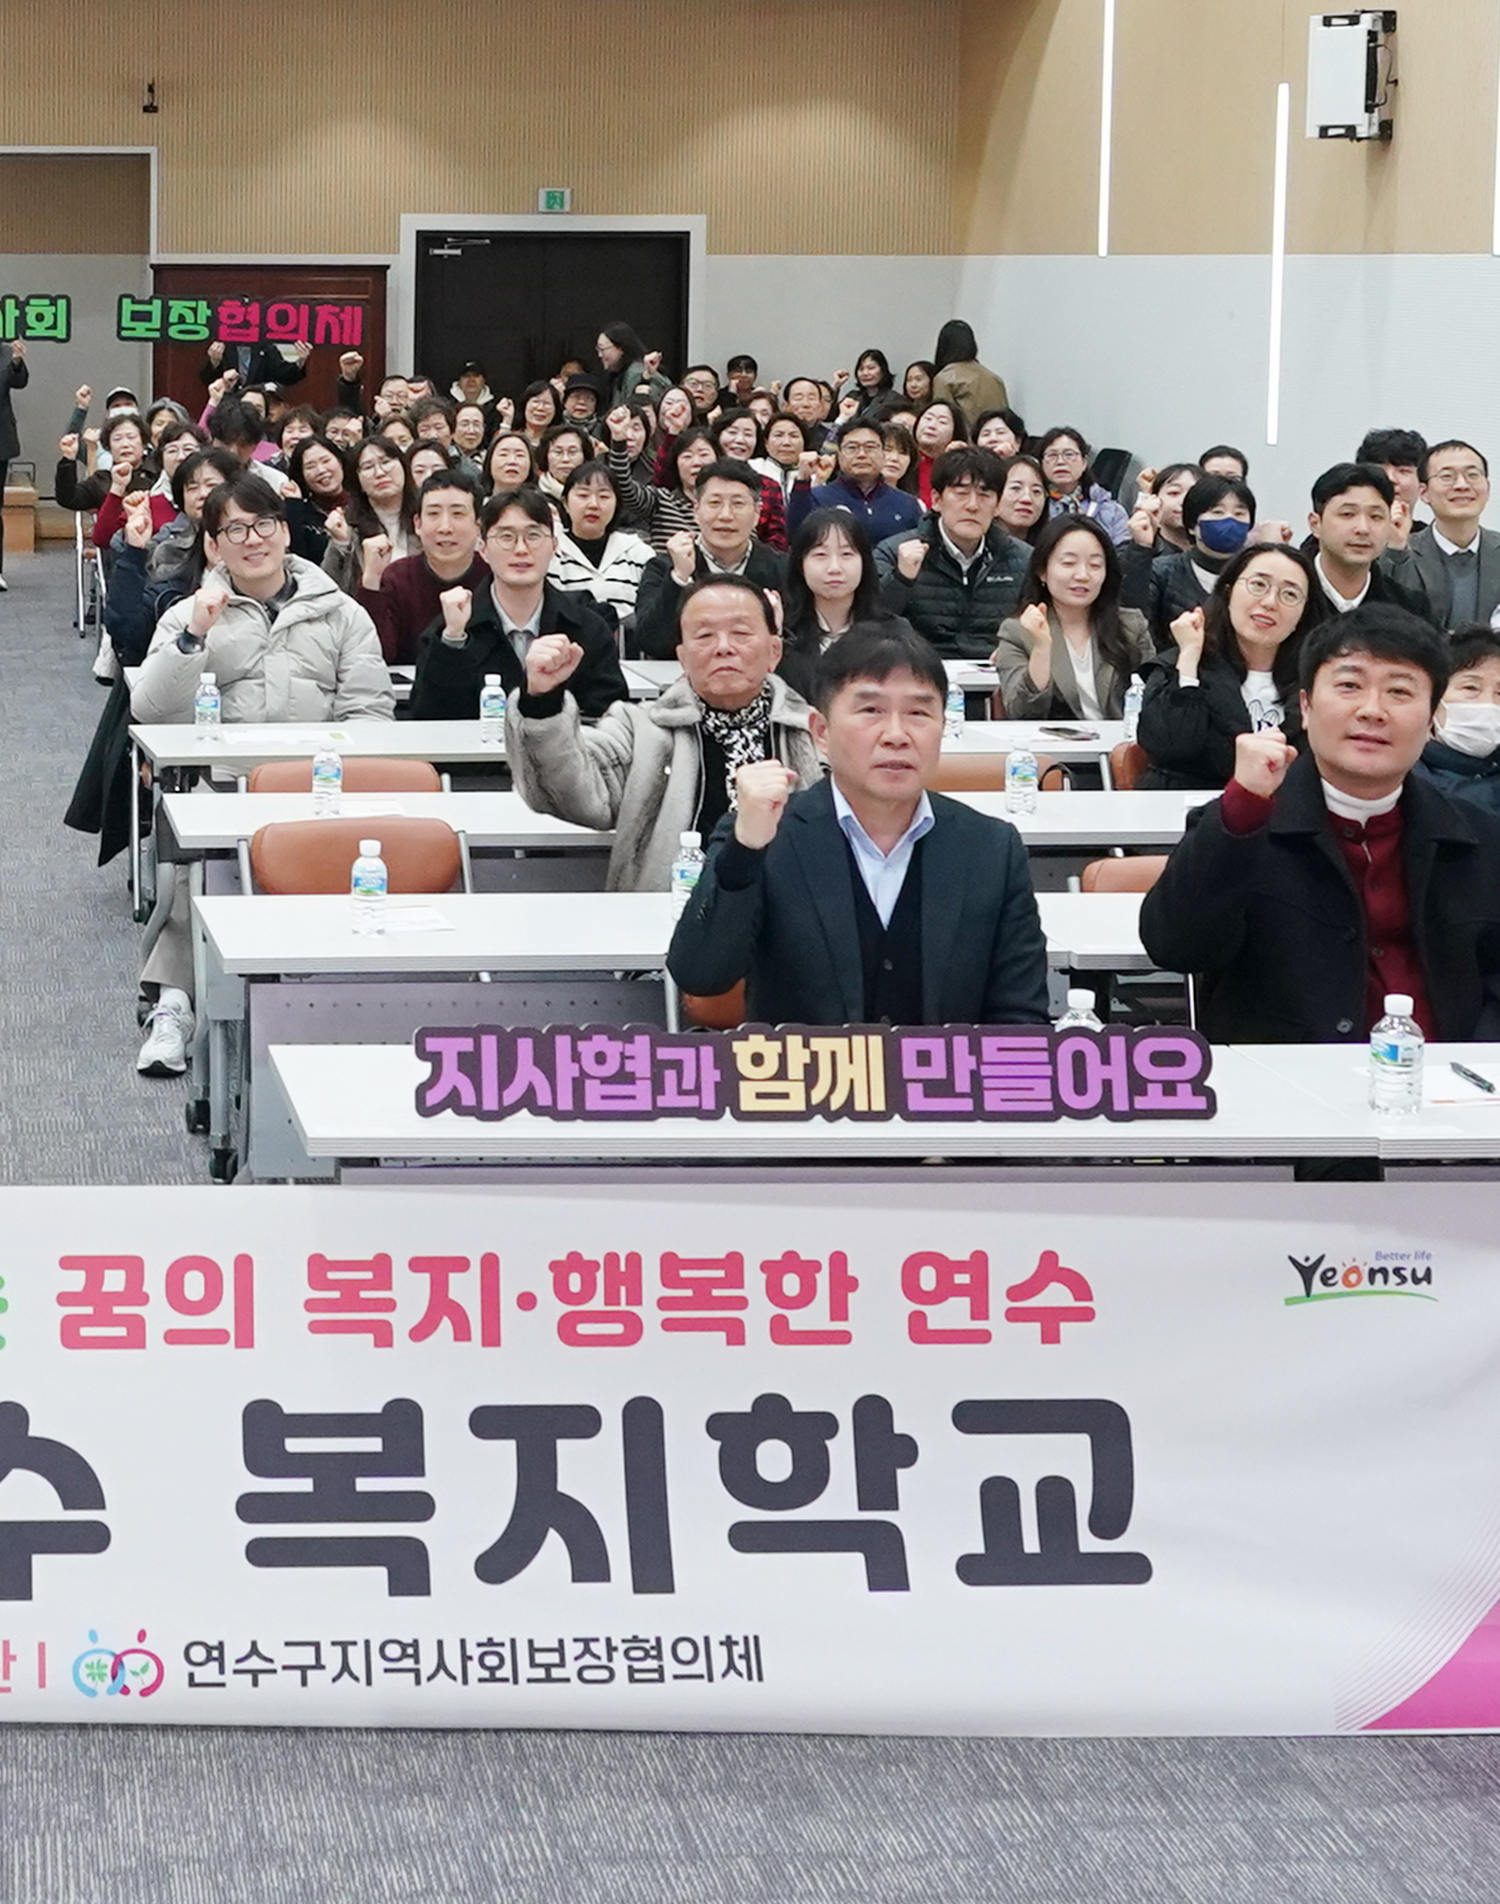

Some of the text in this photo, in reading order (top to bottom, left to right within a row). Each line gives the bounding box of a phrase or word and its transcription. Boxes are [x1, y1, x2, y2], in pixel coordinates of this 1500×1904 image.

[424, 1034, 1208, 1112] 지사협과 함께 만들어요
[1287, 1253, 1433, 1298] Yeonsu
[1374, 1250, 1433, 1262] Better life
[55, 1252, 256, 1350] 꿈의
[900, 1248, 1097, 1346] 연수
[234, 1391, 1154, 1600] 복지학교
[182, 1634, 766, 1689] 연수구지역사회보장협의체
